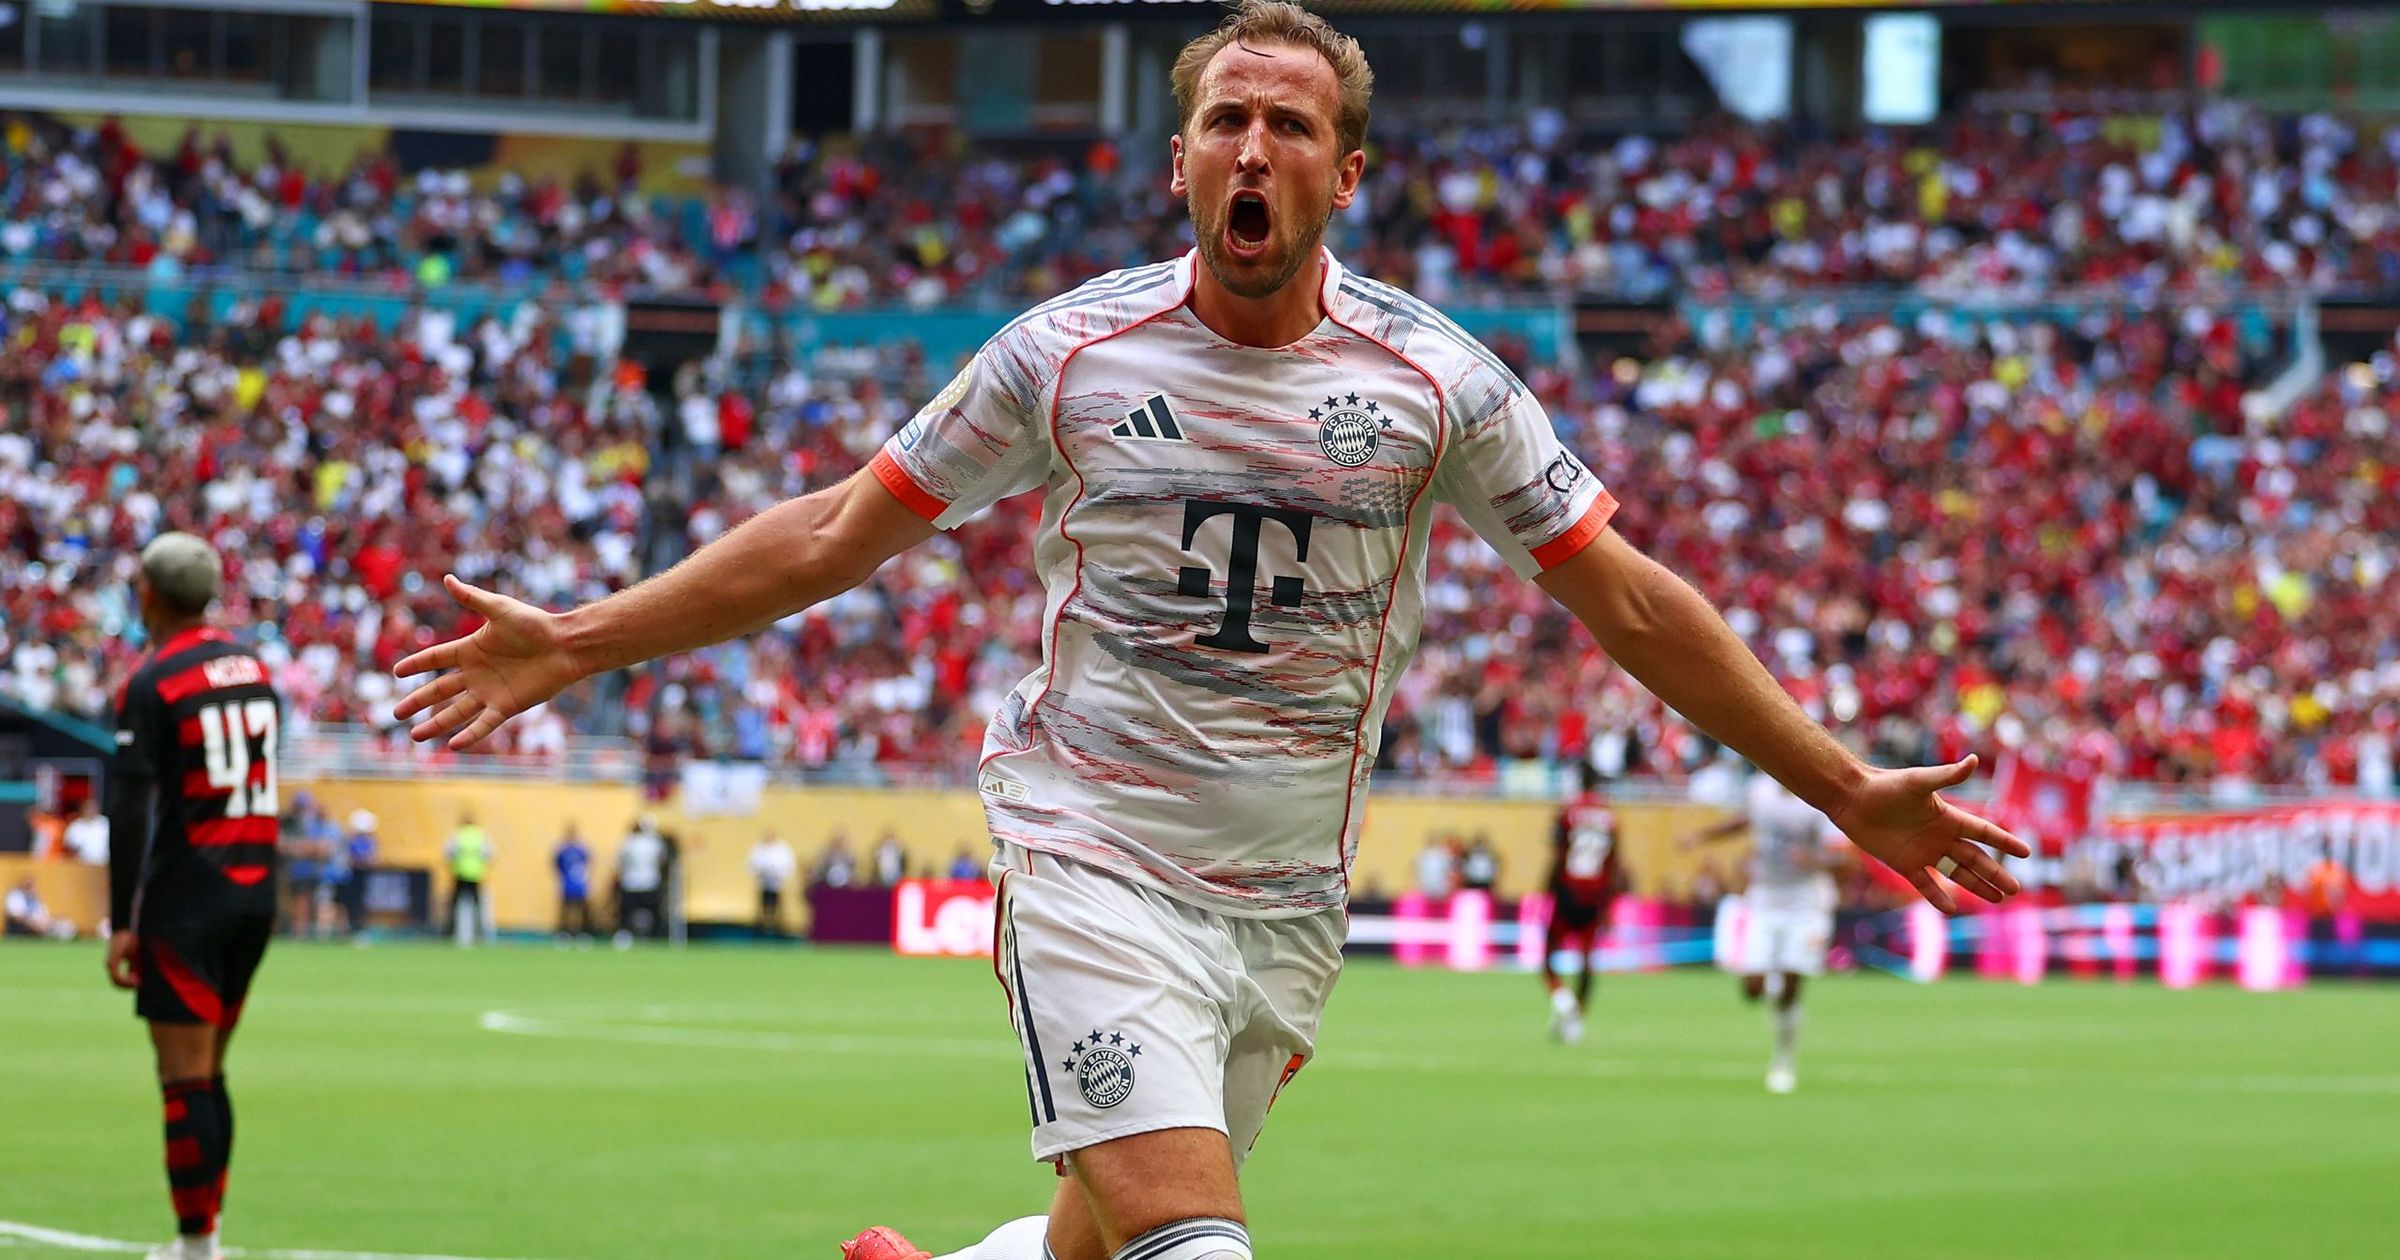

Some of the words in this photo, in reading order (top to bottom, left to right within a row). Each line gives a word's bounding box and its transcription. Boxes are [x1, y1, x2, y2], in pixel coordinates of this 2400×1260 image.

[1325, 418, 1338, 432] FC
[1338, 413, 1375, 437] BAYERN
[1178, 499, 1313, 654] T
[199, 698, 279, 819] 43
[1080, 1064, 1090, 1079] FC
[1088, 1051, 1128, 1070] BAYERN
